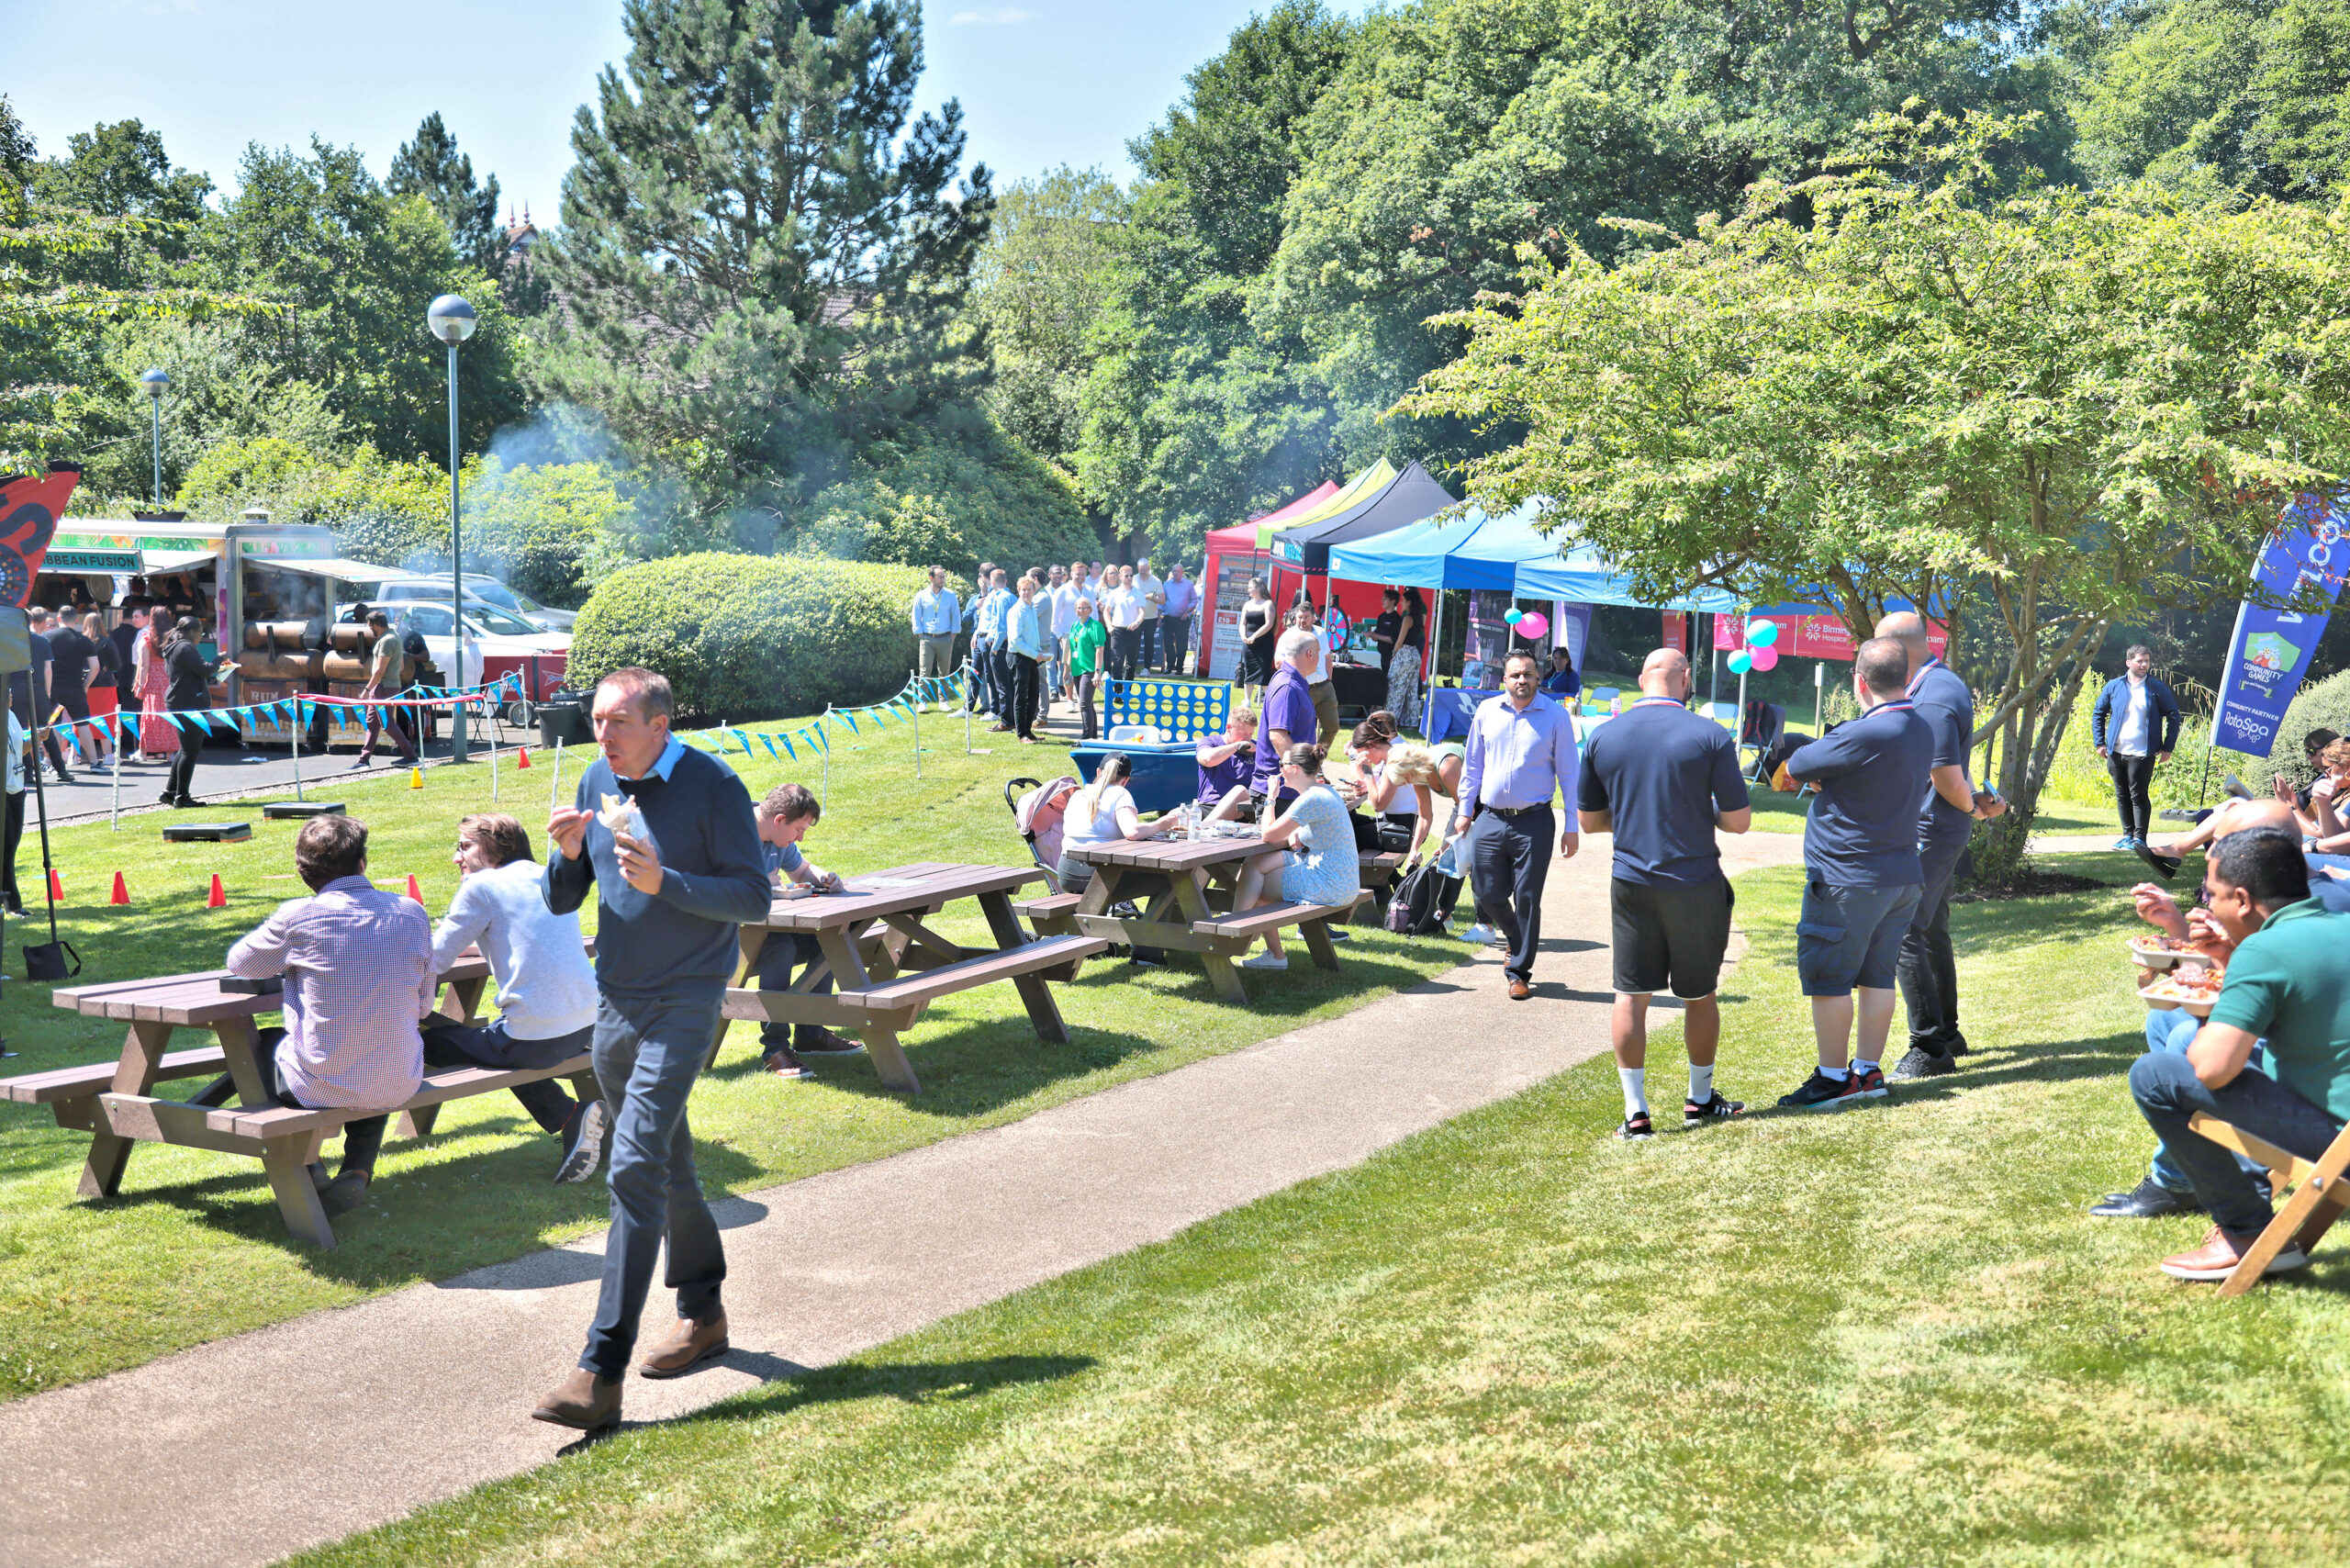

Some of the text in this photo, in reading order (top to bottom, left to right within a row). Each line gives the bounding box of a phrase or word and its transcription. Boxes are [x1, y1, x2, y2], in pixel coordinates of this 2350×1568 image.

[89, 555, 136, 567] FUSION
[1822, 624, 1852, 637] Birming
[1822, 633, 1848, 644] Hospice
[2243, 662, 2283, 680] COMMUNITY
[2248, 671, 2270, 683] GAMES
[2226, 700, 2278, 721] COMMUNITY PARTNER
[2224, 711, 2269, 737] RotoSpa
